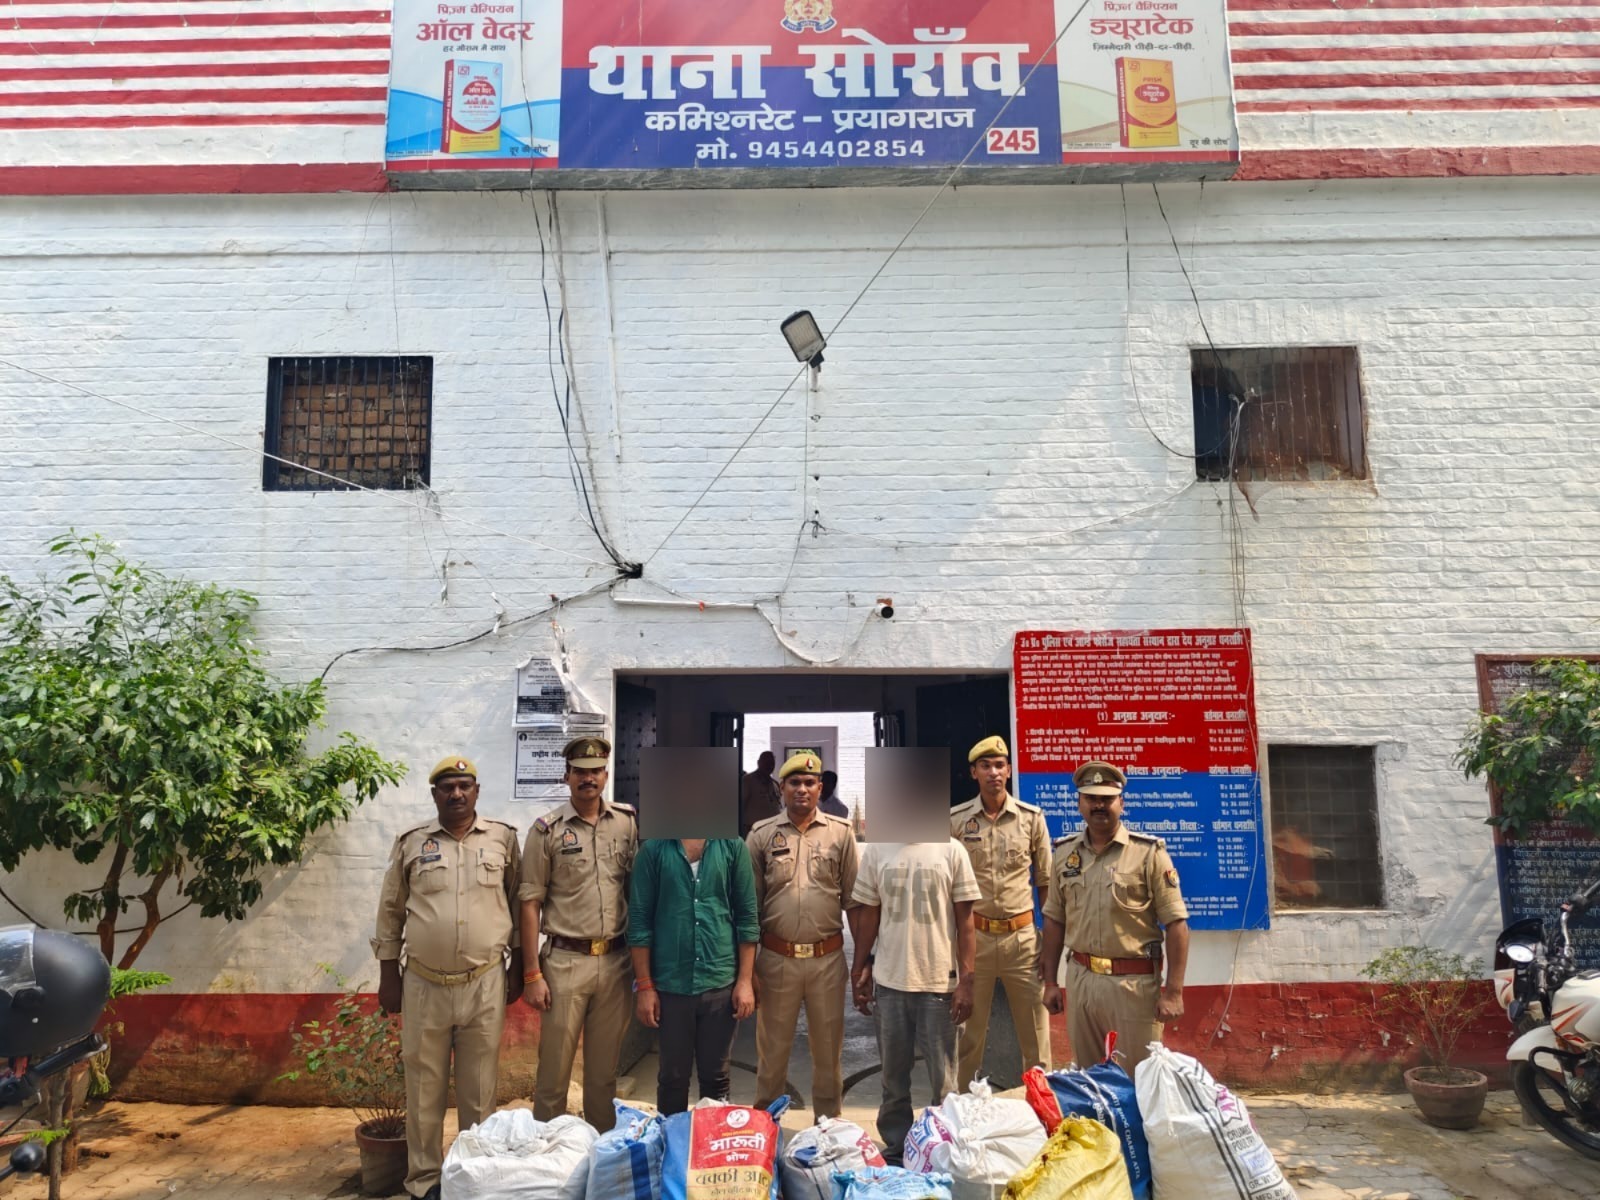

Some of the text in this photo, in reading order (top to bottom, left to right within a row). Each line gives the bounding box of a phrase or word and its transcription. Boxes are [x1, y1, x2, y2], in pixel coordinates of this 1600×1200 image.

[416, 17, 535, 41] ऑल वेदर
[1090, 13, 1194, 40] ड्यूराटेक
[490, 44, 506, 52] साथ
[589, 45, 772, 100] थाना
[644, 102, 796, 131] कमिश्नरेट
[832, 108, 976, 134] प्रयागराज
[696, 138, 925, 160] मो. 9454402854
[989, 130, 1036, 151] 245
[1189, 138, 1199, 148] दूर
[1201, 137, 1210, 145] की
[1042, 634, 1061, 650] पुलिस
[709, 1132, 766, 1152] मारूती
[1124, 1129, 1136, 1159] CHAKKI
[1132, 1160, 1140, 1180] ATTA
